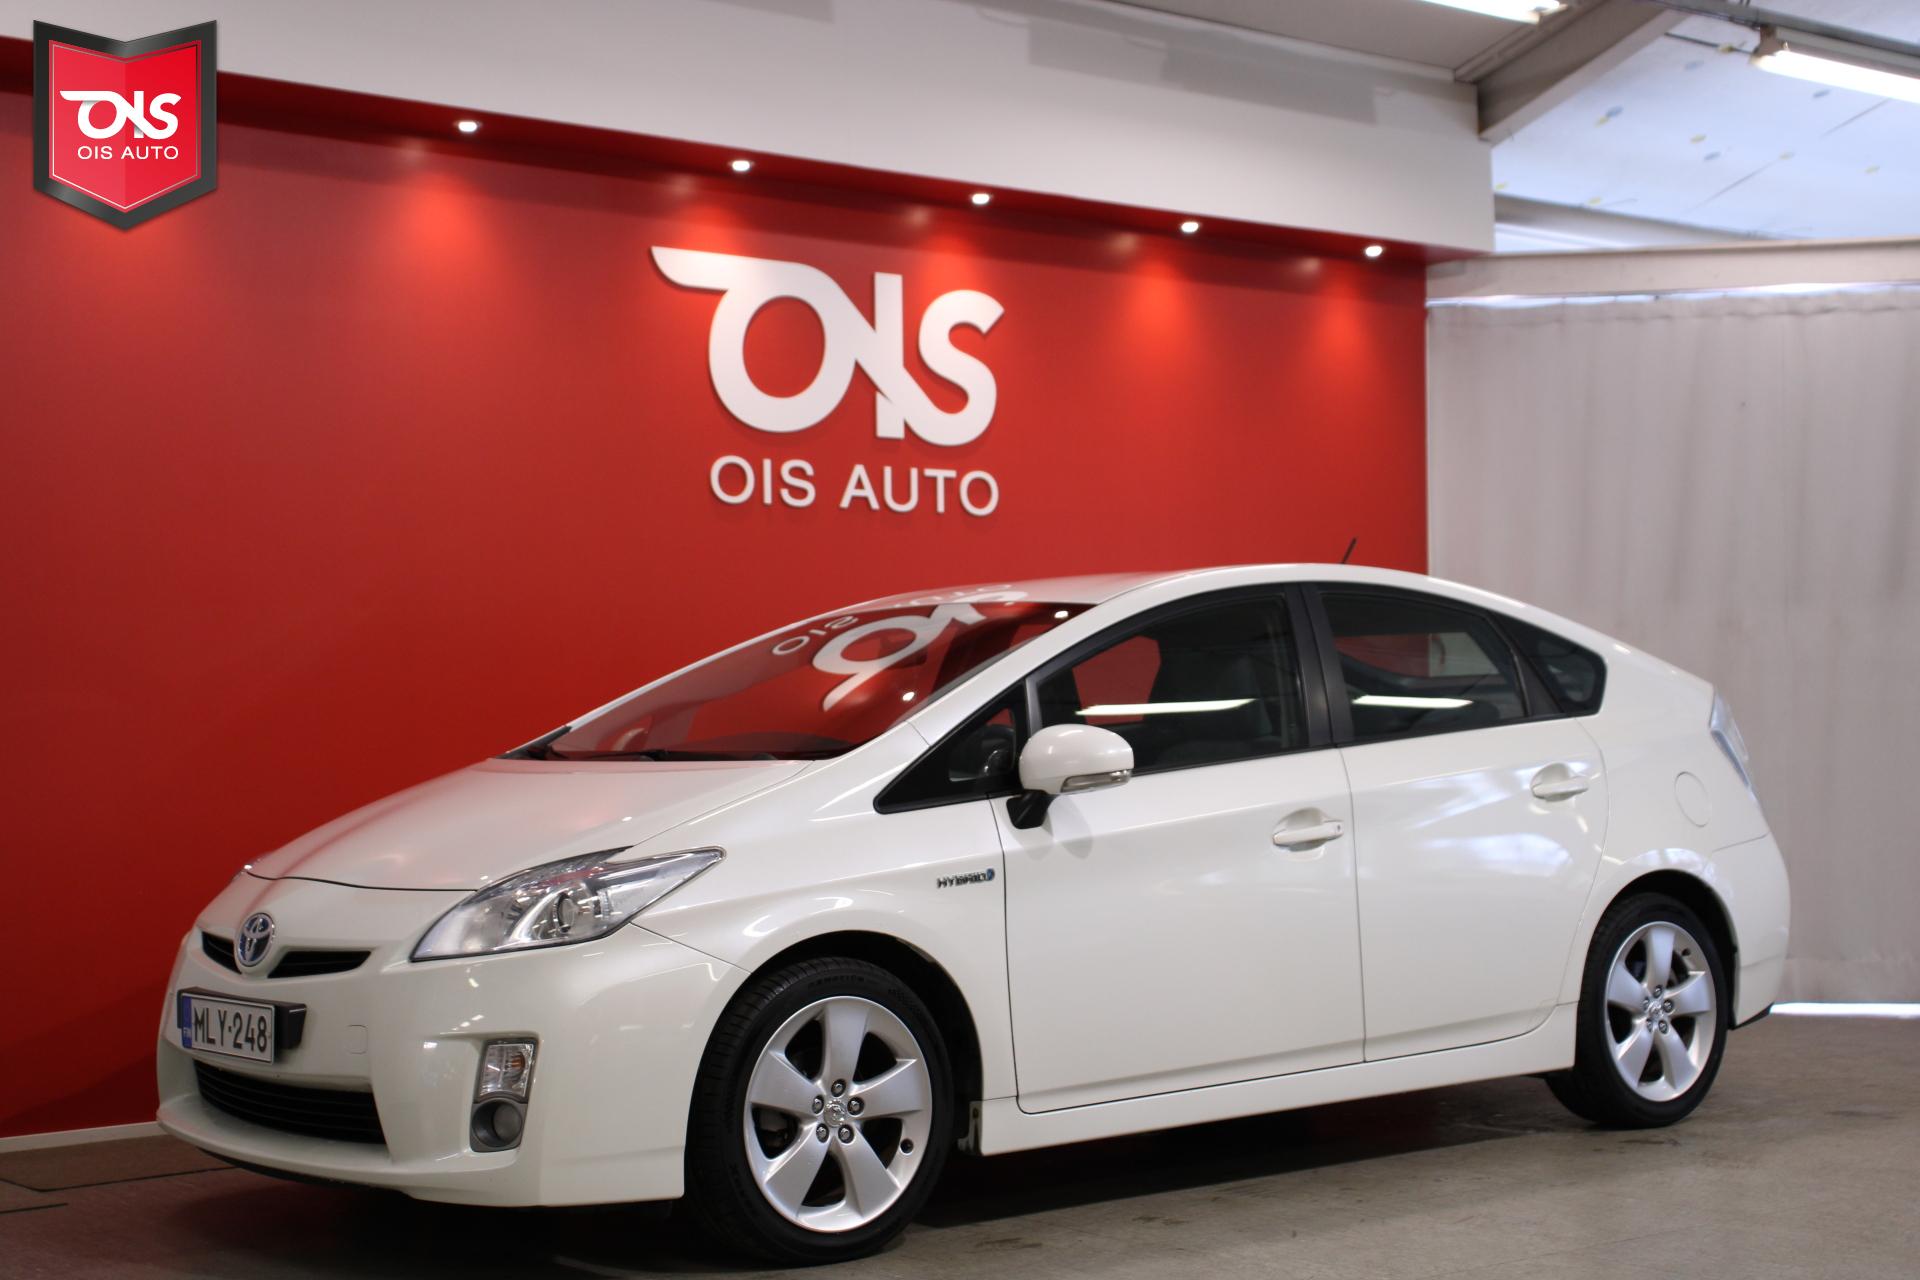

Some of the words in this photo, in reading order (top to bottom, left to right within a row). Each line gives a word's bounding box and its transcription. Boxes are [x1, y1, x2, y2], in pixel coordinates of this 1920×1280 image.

[651, 246, 1004, 446] OIS
[710, 455, 816, 508] OIS
[840, 464, 999, 516] AUTO
[194, 1007, 267, 1053] MLY-248
